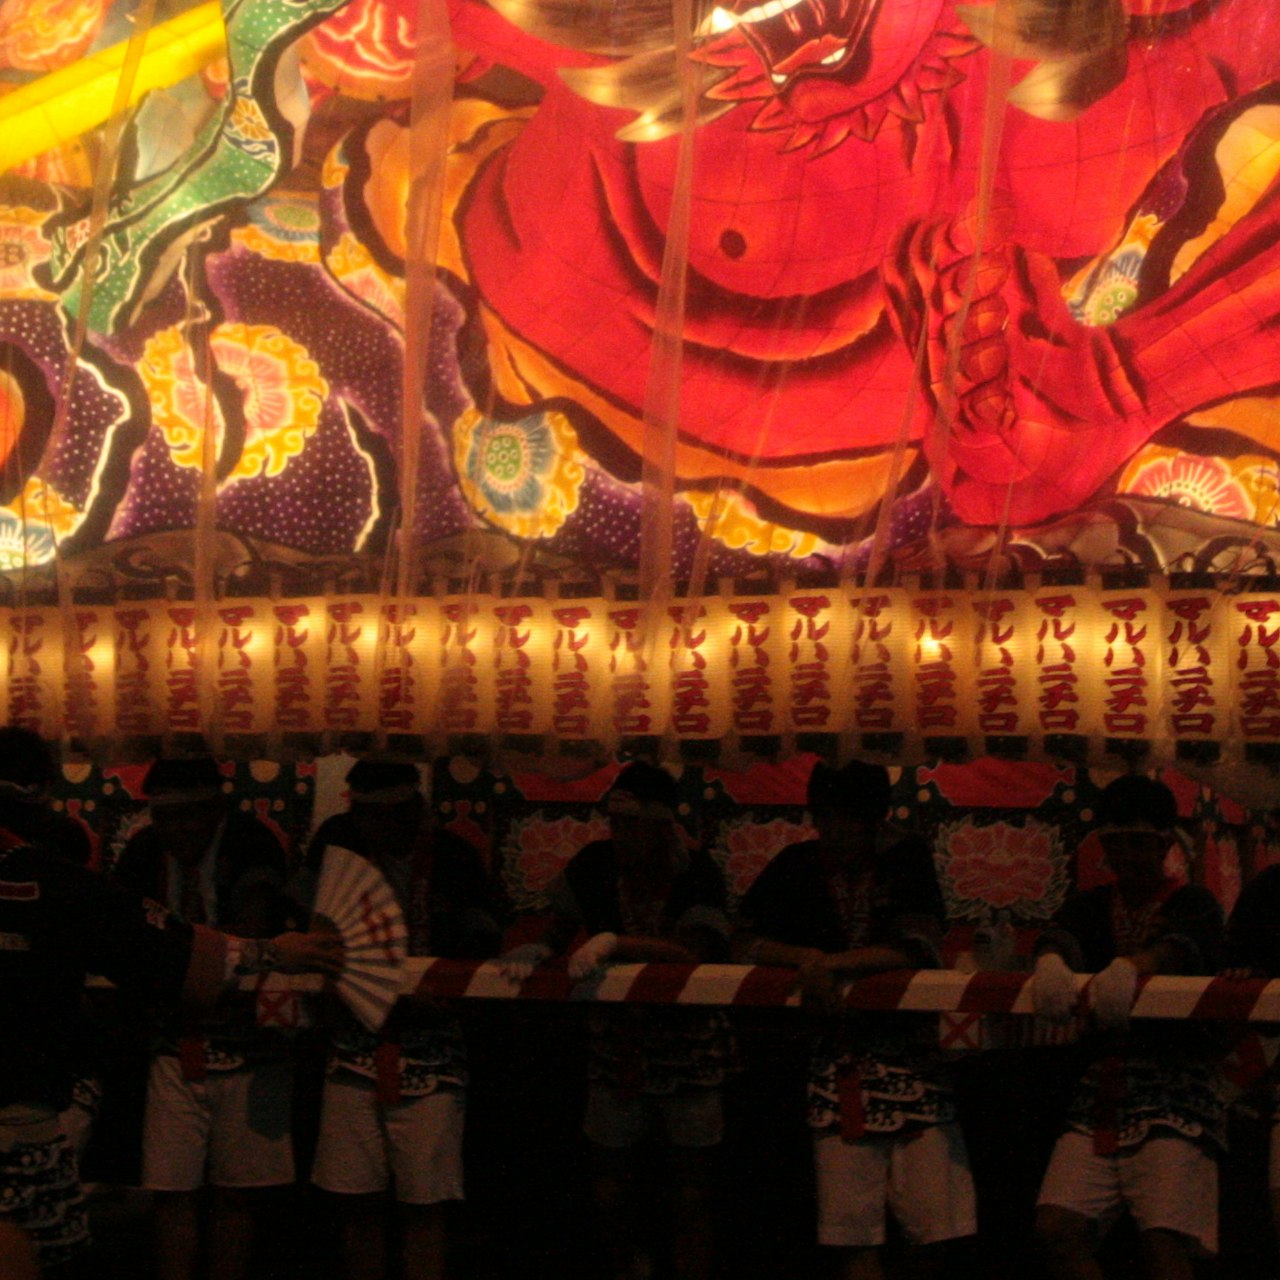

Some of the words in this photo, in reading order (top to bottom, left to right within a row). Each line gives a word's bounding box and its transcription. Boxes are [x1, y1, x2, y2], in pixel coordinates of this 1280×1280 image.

[218, 605, 254, 729] マルハニチロ
[273, 604, 311, 728] マルハニチロ
[323, 602, 363, 725] マルハニチロ
[494, 604, 533, 729] マルハニチロ
[552, 605, 591, 733] マルハニチロ
[608, 608, 651, 732] マルハニチロ
[667, 605, 710, 734] マルハニチロ
[728, 601, 774, 731] マルハニチロ
[789, 595, 831, 726] マルハニチロ
[849, 595, 895, 728] マルハニチロ
[912, 597, 958, 728] マルハニチロ
[972, 598, 1018, 732] マルハニチロ
[1035, 594, 1079, 730] マルハニチロ
[1102, 596, 1147, 734] マルハニチロ
[1166, 596, 1216, 734] マルハニチロ
